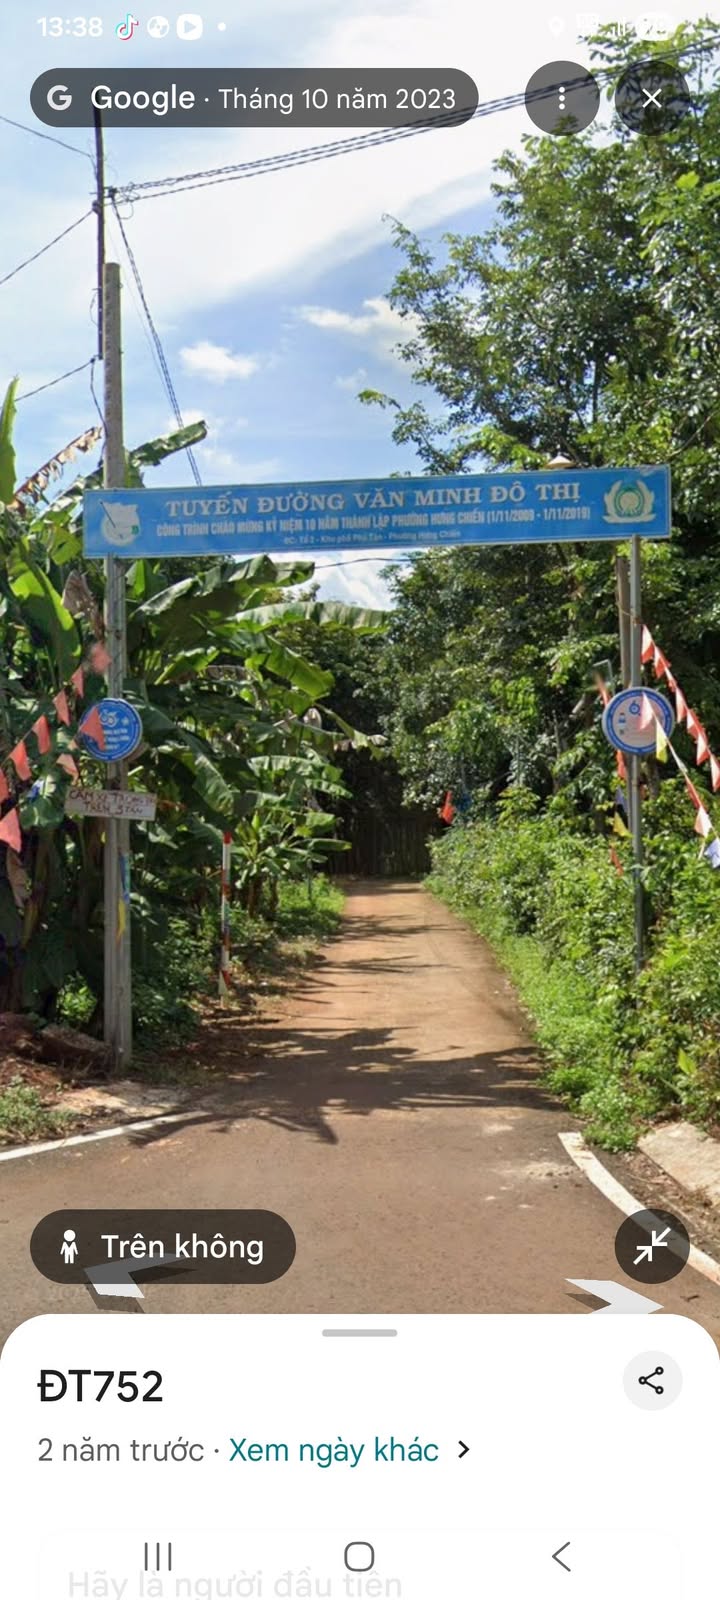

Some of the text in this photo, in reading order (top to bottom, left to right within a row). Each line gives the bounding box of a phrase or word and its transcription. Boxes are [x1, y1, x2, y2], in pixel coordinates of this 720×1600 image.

[166, 481, 581, 517] TUYẾN ĐƯỜNG VĂN MINH ĐÔ THỊ
[156, 522, 181, 537] CÔNG
[305, 519, 317, 531] 10
[318, 515, 340, 531] NĂM
[342, 514, 371, 530] THÀNH
[372, 512, 390, 530] LẬP
[392, 511, 430, 527] PHƯỜNG
[457, 508, 486, 524] CHIẾN
